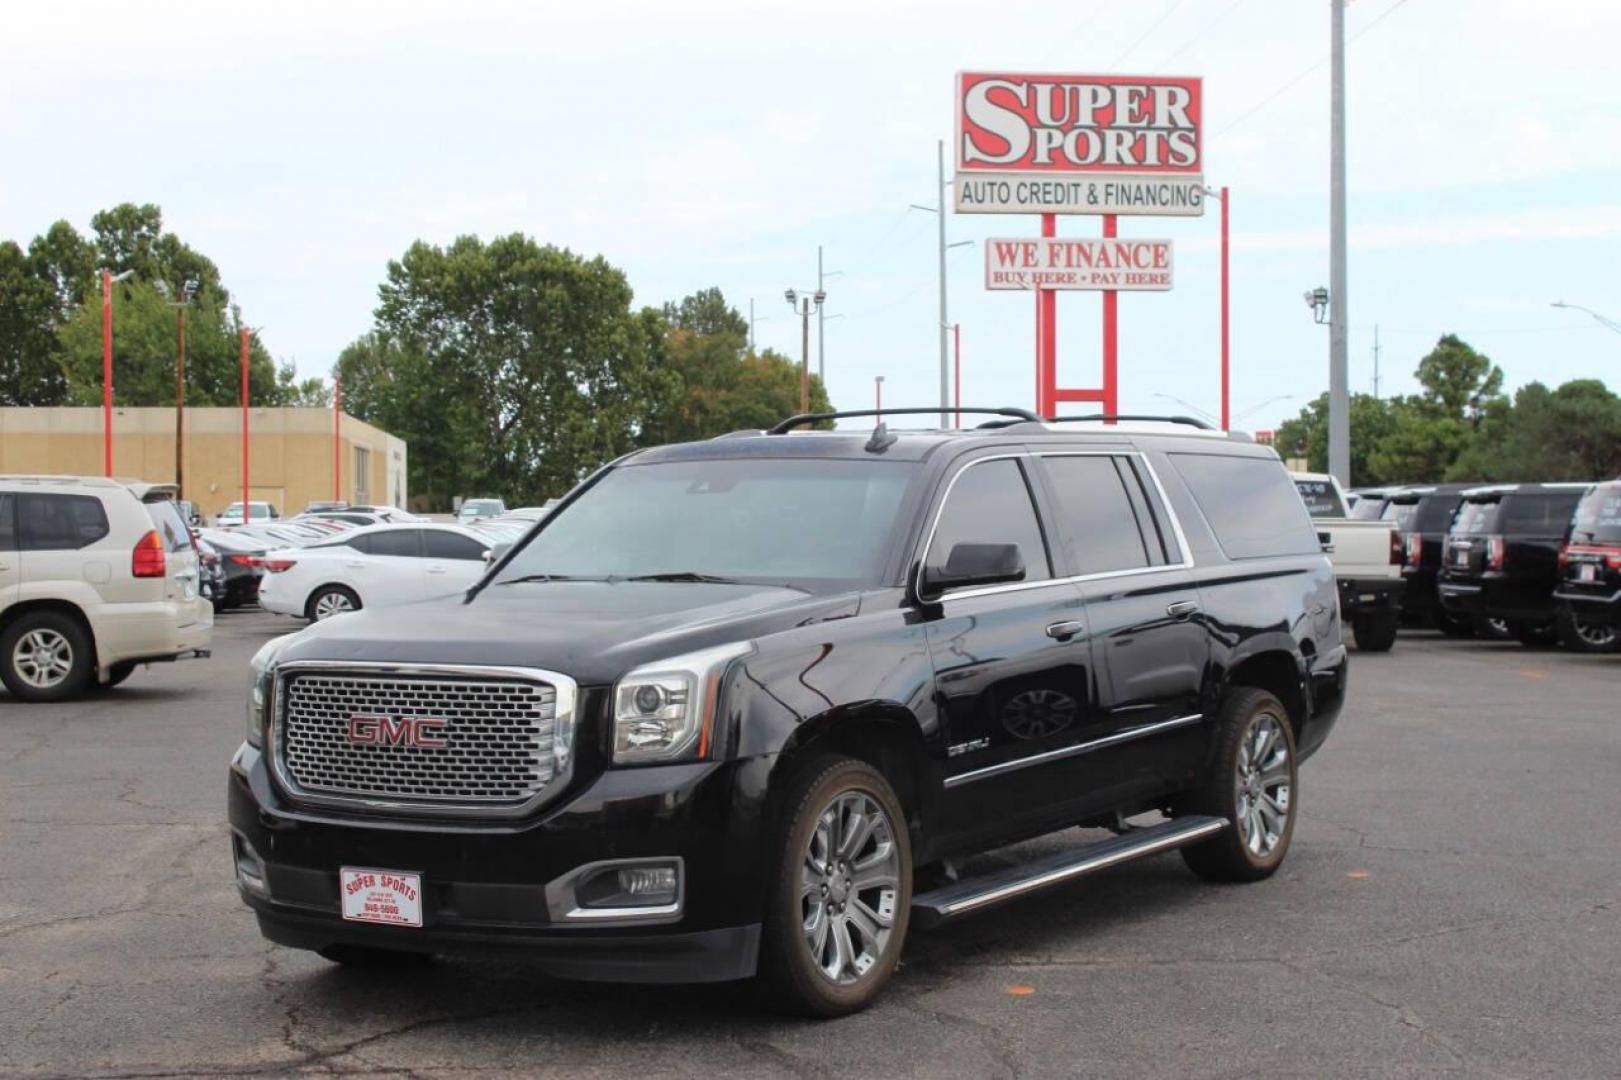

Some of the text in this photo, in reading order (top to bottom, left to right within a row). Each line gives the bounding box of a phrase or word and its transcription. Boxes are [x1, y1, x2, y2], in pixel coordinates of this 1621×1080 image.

[961, 181, 1201, 207] AUTO CREDIT & FINANCING
[994, 241, 1169, 268] WE FINANCE
[993, 271, 1170, 285] BUY HERE PAY HERE
[349, 714, 448, 747] GMC
[346, 874, 416, 901] SUPER SPORTS
